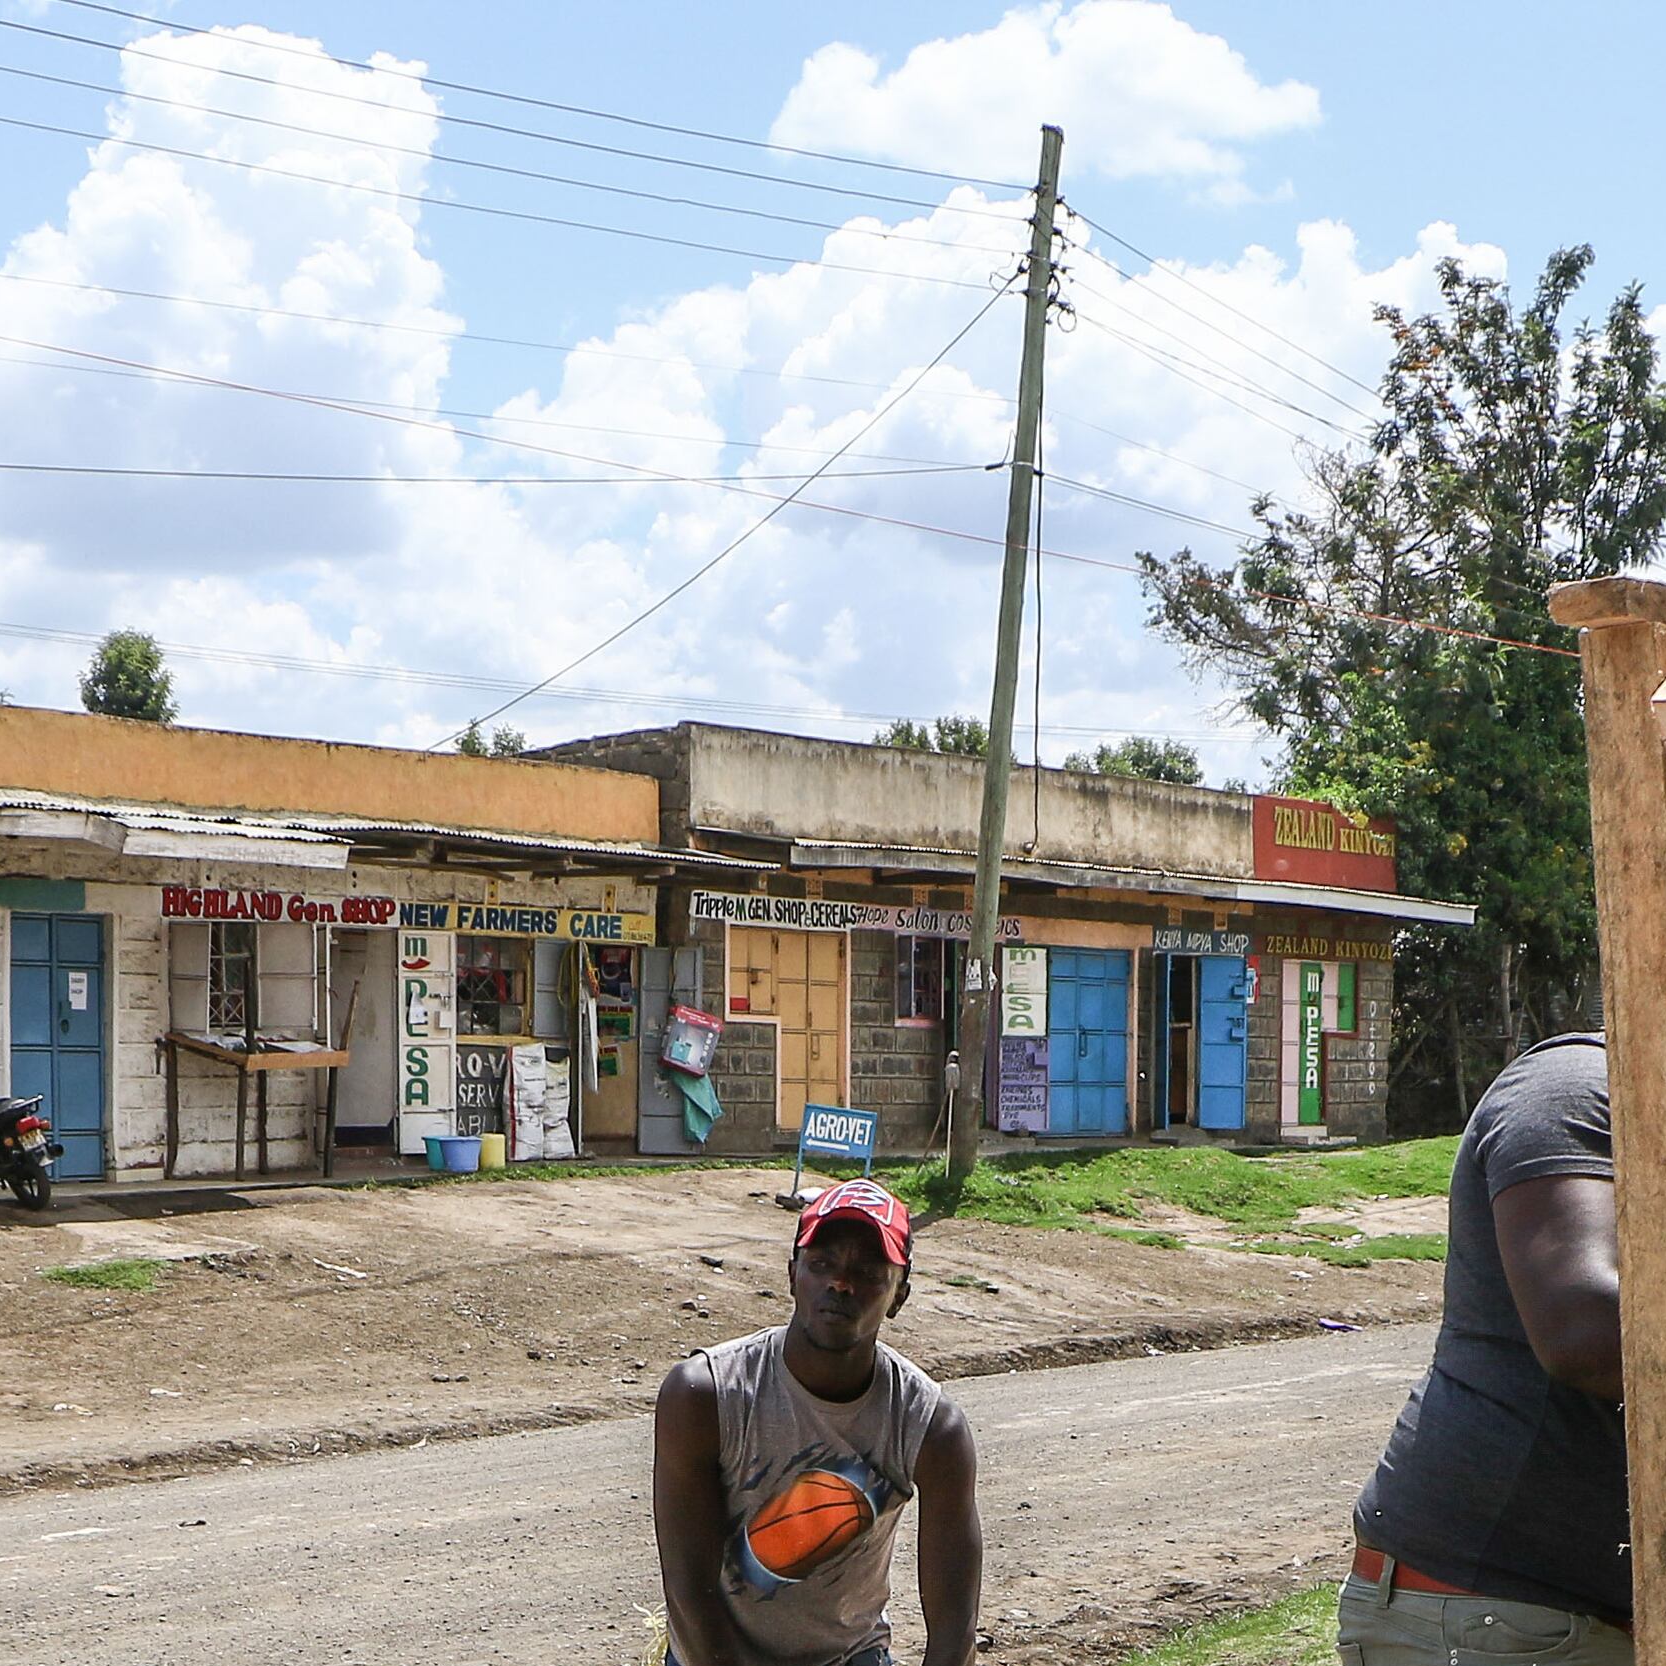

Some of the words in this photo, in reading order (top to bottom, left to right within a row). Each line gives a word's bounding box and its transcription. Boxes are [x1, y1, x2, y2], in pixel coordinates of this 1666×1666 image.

[1274, 806, 1335, 850] ZEALAND
[161, 886, 283, 921] HIGHLAND
[287, 894, 338, 923] Gen.
[341, 896, 396, 925] SHOP
[400, 903, 449, 928] NEW
[569, 912, 622, 940] CARE
[693, 892, 734, 918] Tripple
[774, 899, 806, 928] SHOP
[811, 902, 857, 928] CEREALS
[895, 907, 939, 932] Salon
[1154, 930, 1182, 950] KENYA
[1185, 932, 1212, 952] MPYA
[1220, 934, 1249, 954] SHOP
[1266, 936, 1328, 956] ZEALAND
[1334, 940, 1394, 962] KINYOZI
[804, 1111, 873, 1146] AGRO-VET
